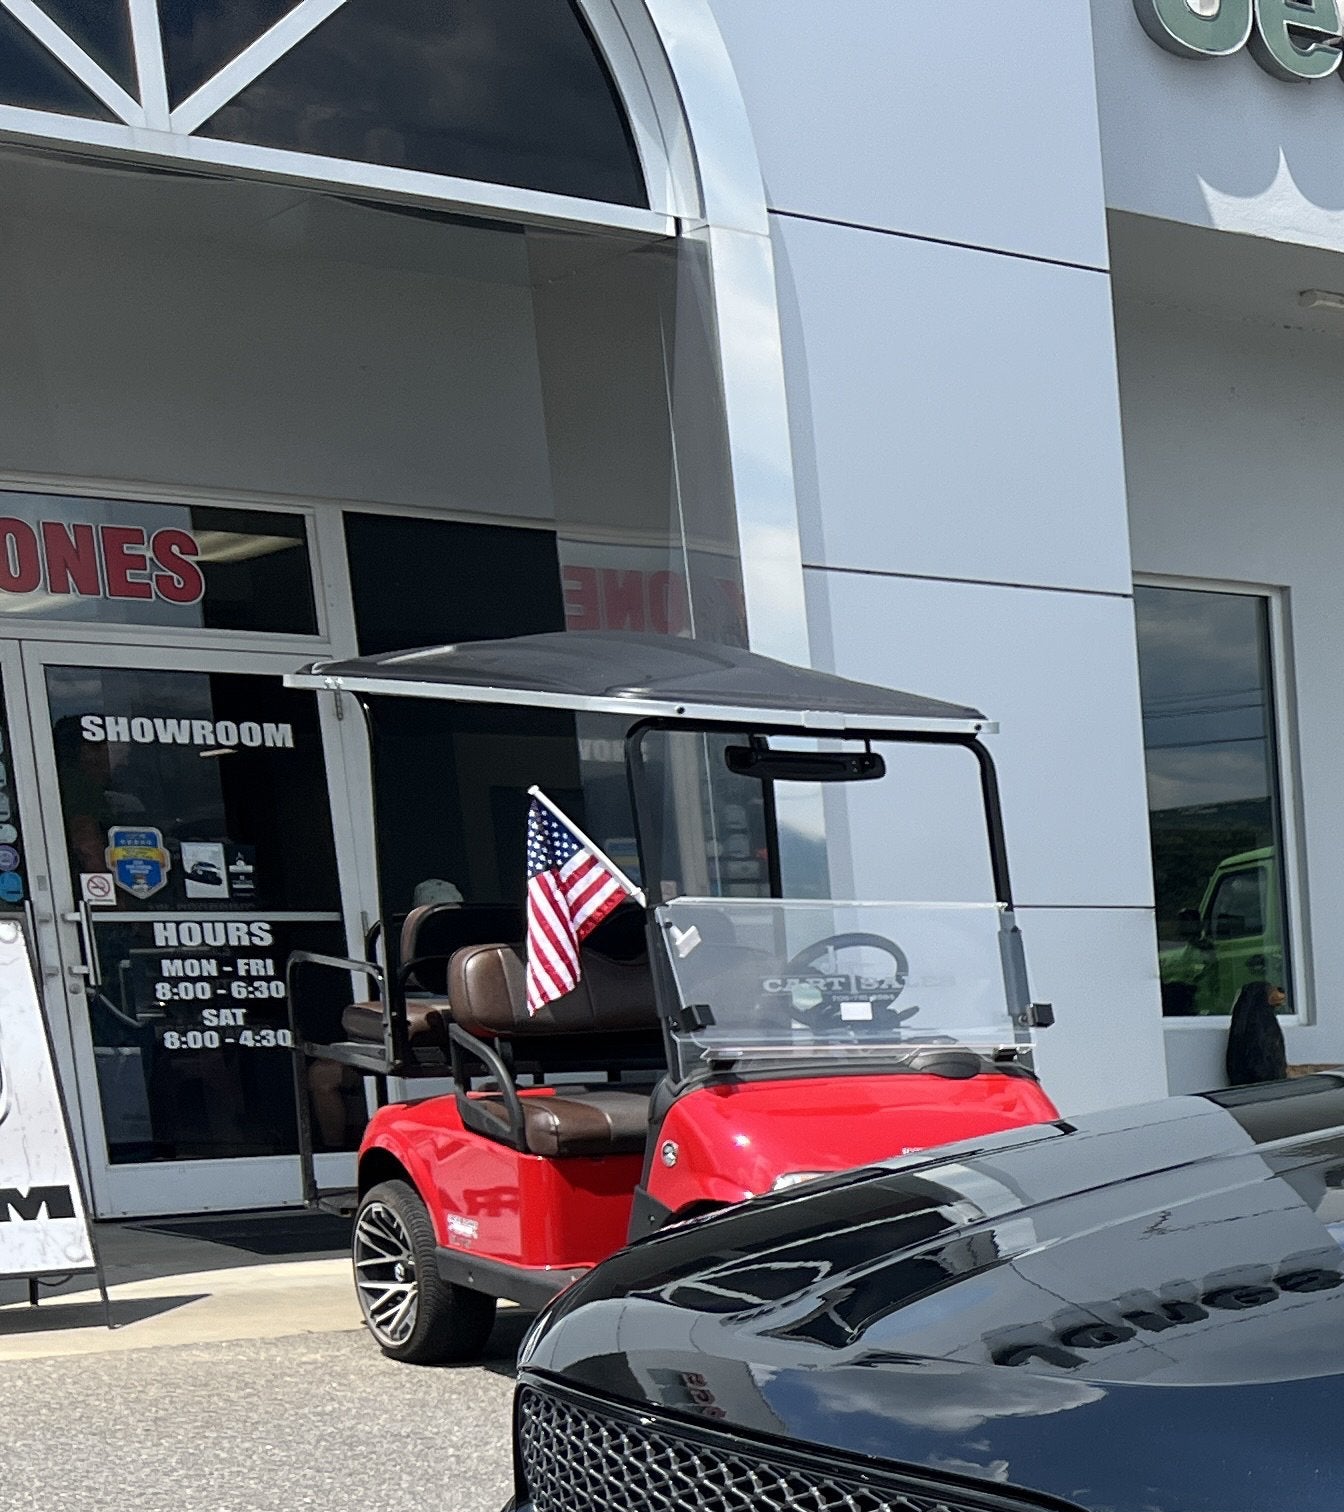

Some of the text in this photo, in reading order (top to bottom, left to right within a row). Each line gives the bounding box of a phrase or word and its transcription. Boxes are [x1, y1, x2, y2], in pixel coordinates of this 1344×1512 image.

[0, 516, 206, 605] ONES
[80, 715, 295, 748] SHOWROOM
[153, 921, 274, 947] HOURS
[161, 958, 218, 977] MON
[236, 958, 275, 976] FRI
[155, 981, 212, 1000] 8:00
[230, 980, 286, 999] 6:30
[762, 976, 845, 993] CART
[202, 1008, 247, 1027] SAT
[163, 1030, 220, 1049] 8:00
[238, 1029, 294, 1047] 4:30
